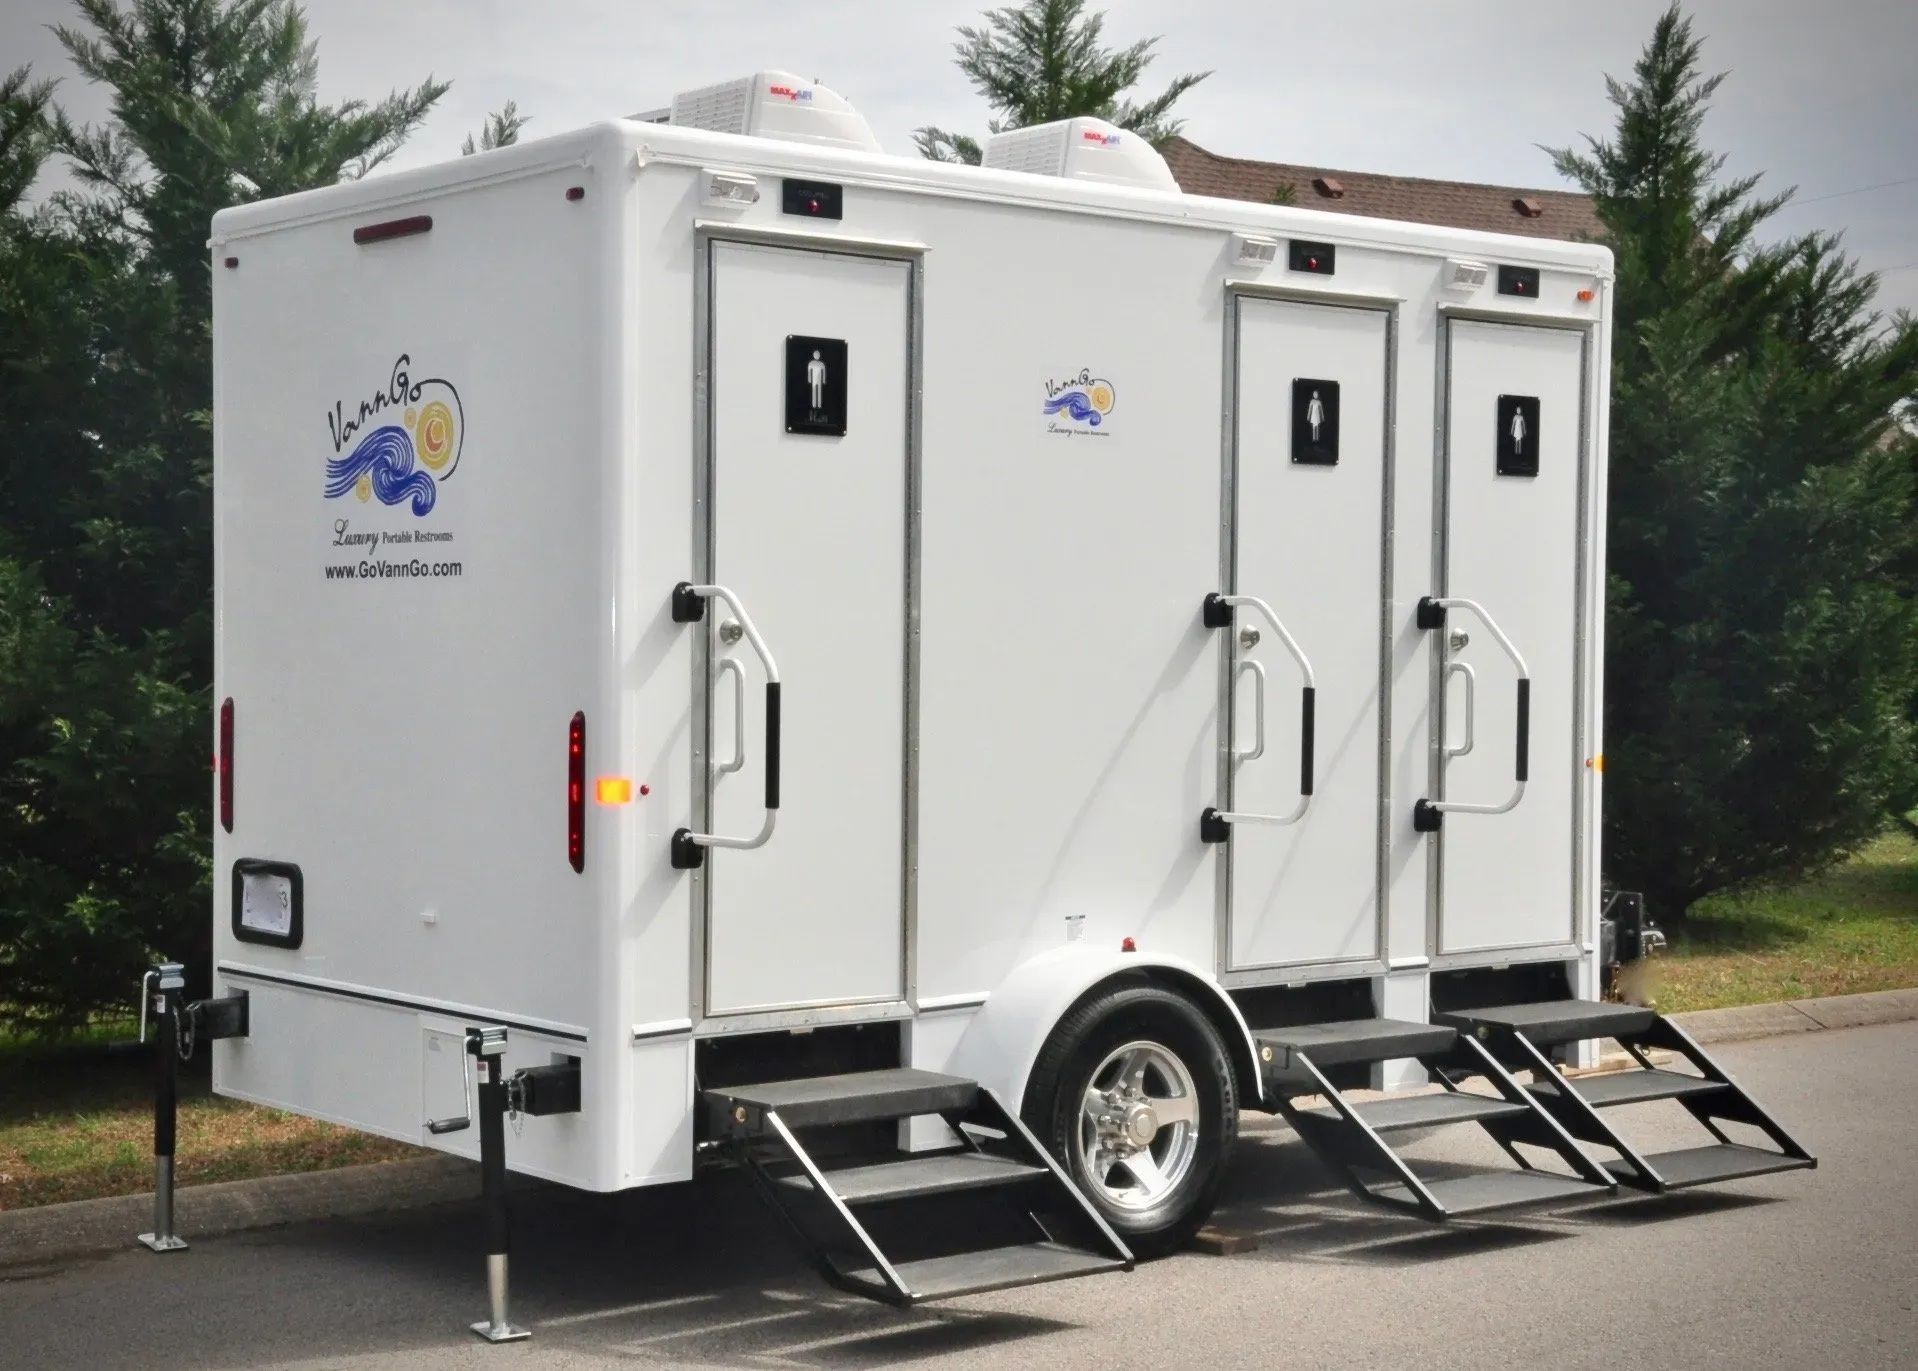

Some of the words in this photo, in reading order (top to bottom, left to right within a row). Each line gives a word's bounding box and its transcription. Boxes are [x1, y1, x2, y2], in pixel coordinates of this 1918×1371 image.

[1045, 367, 1096, 398] VannGo
[327, 353, 422, 453] VannGo
[332, 518, 379, 556] Luxury
[382, 530, 413, 544] Portable
[414, 529, 454, 543] Restrooms
[325, 558, 462, 579] www.GoVannGo.com
